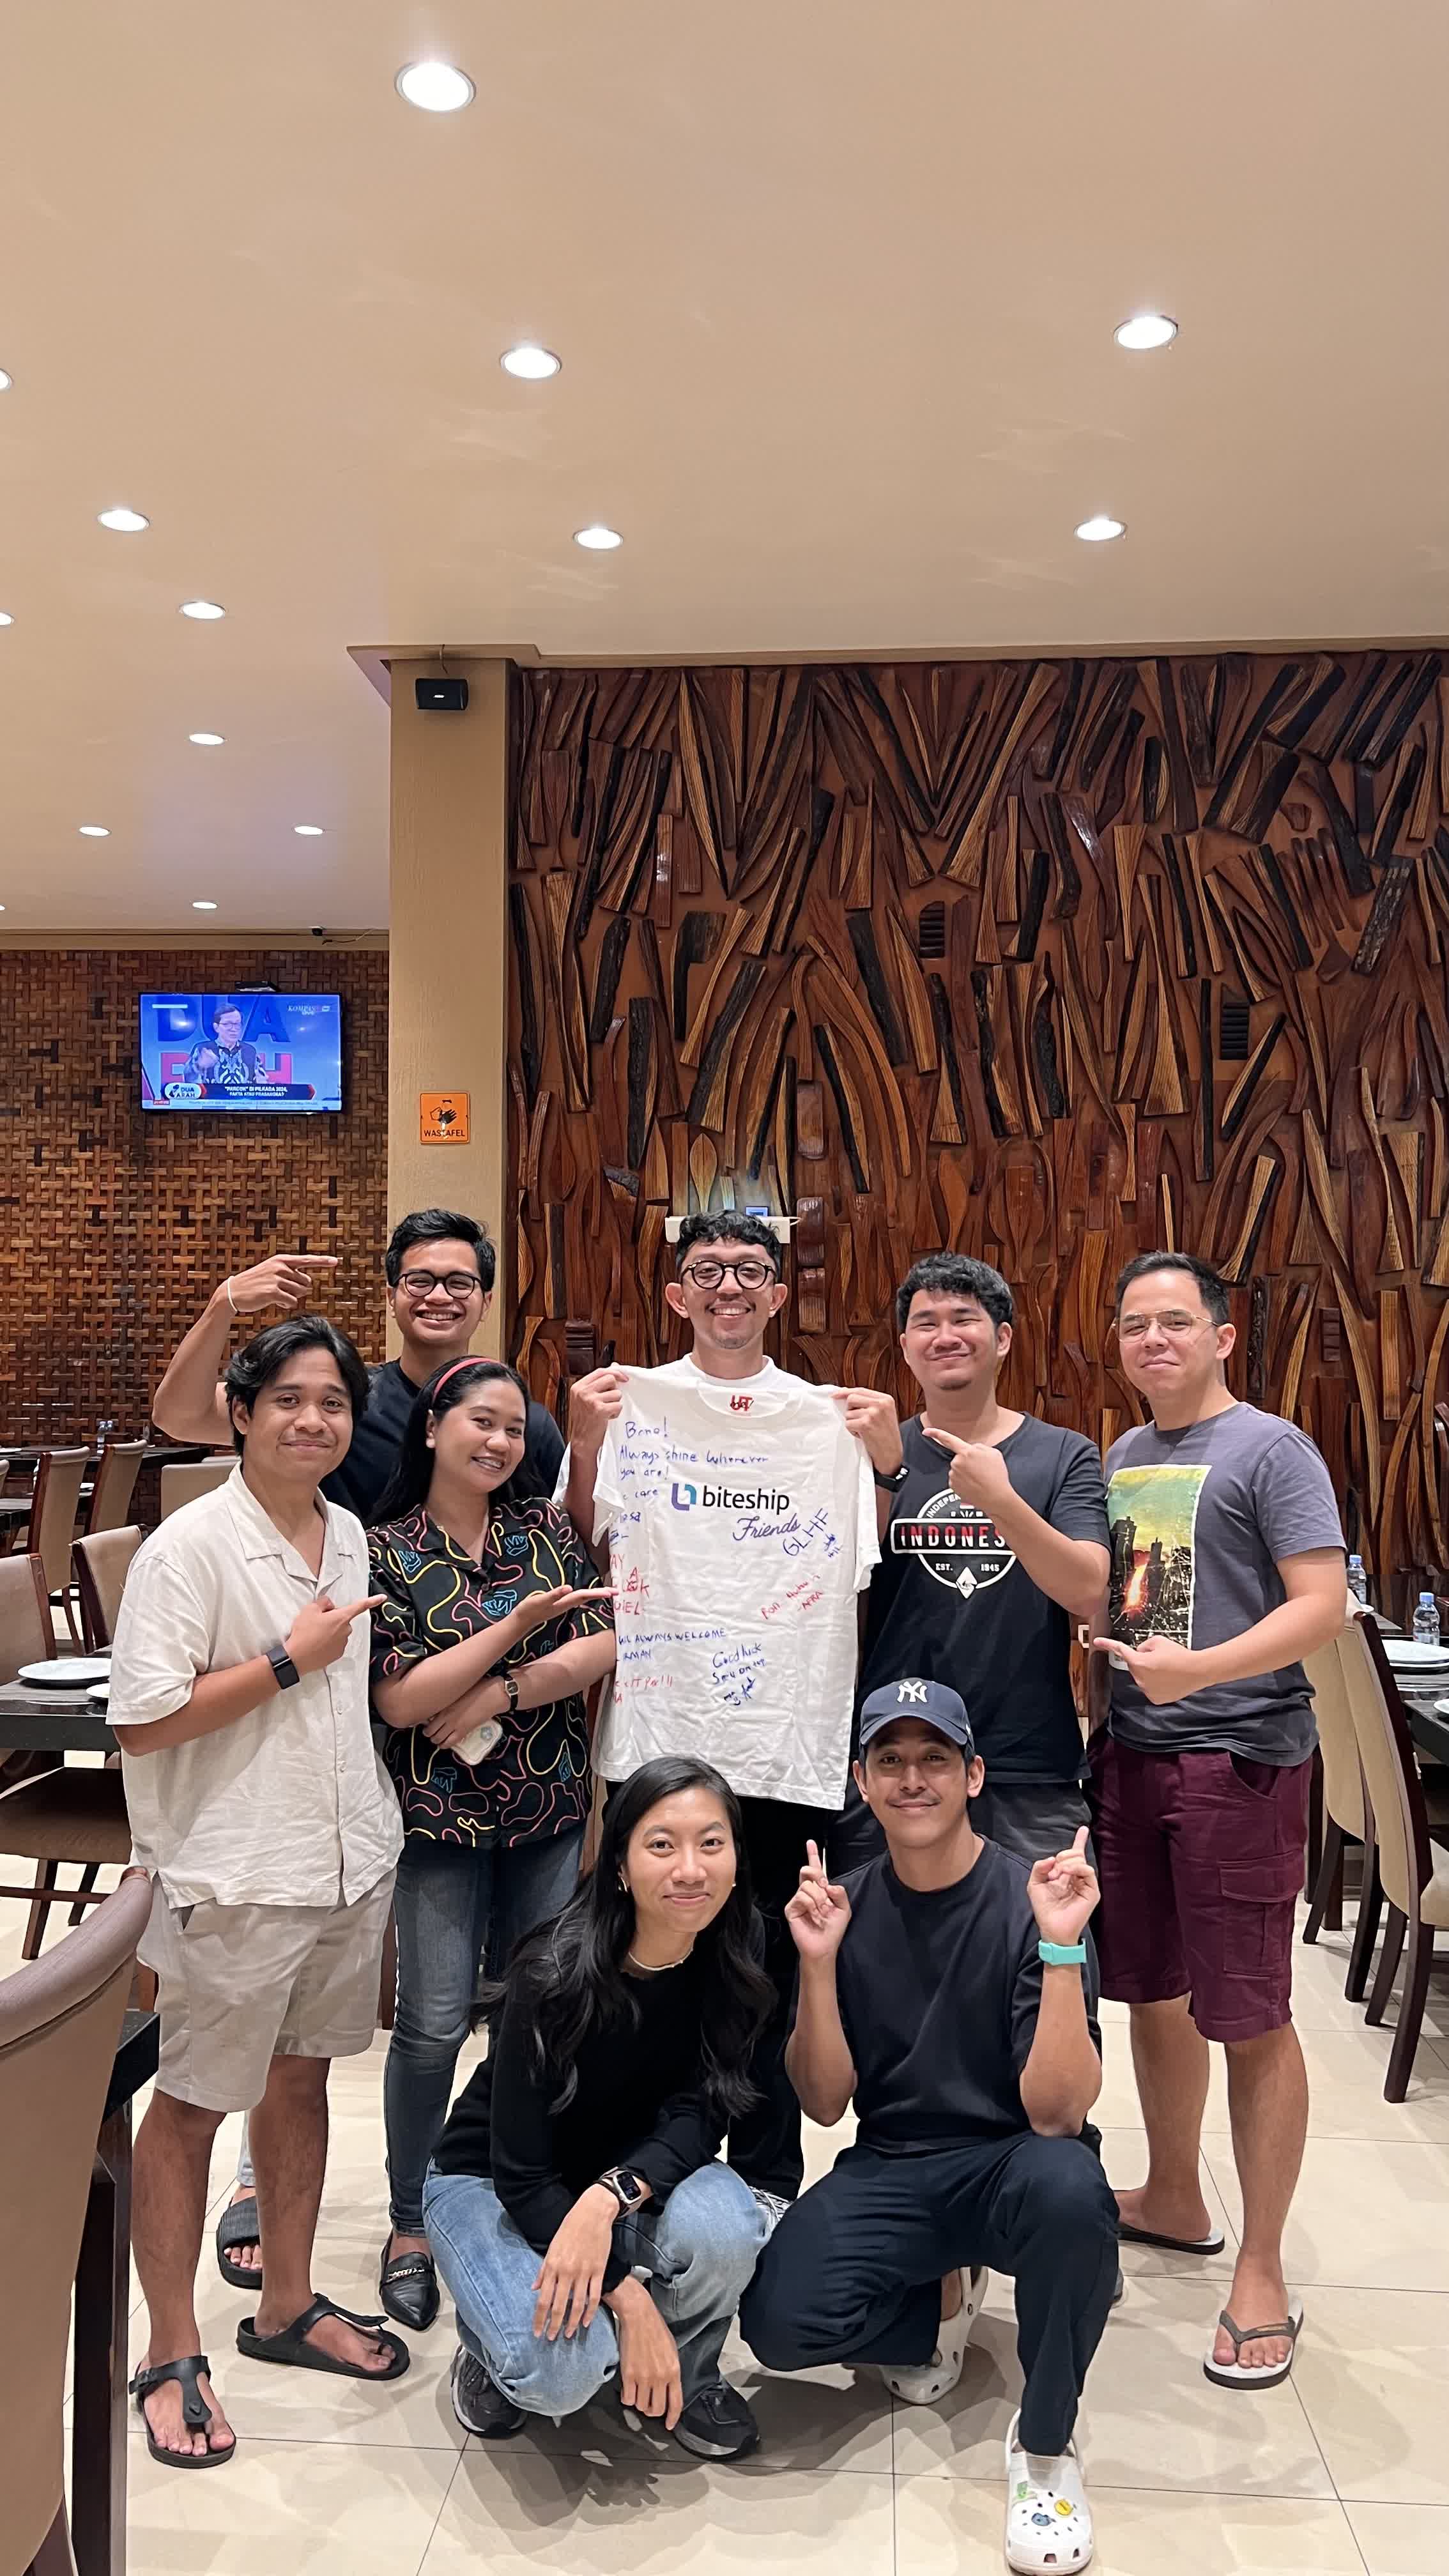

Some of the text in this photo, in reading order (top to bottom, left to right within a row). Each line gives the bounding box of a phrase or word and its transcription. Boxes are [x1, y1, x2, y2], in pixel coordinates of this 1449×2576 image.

[424, 1129, 466, 1137] WASAFEL
[703, 1485, 790, 1515] biteship
[733, 1512, 801, 1541] Friends
[783, 1508, 828, 1556] GLHF
[981, 1563, 1000, 1572] 1945
[896, 1681, 928, 1703] NY
